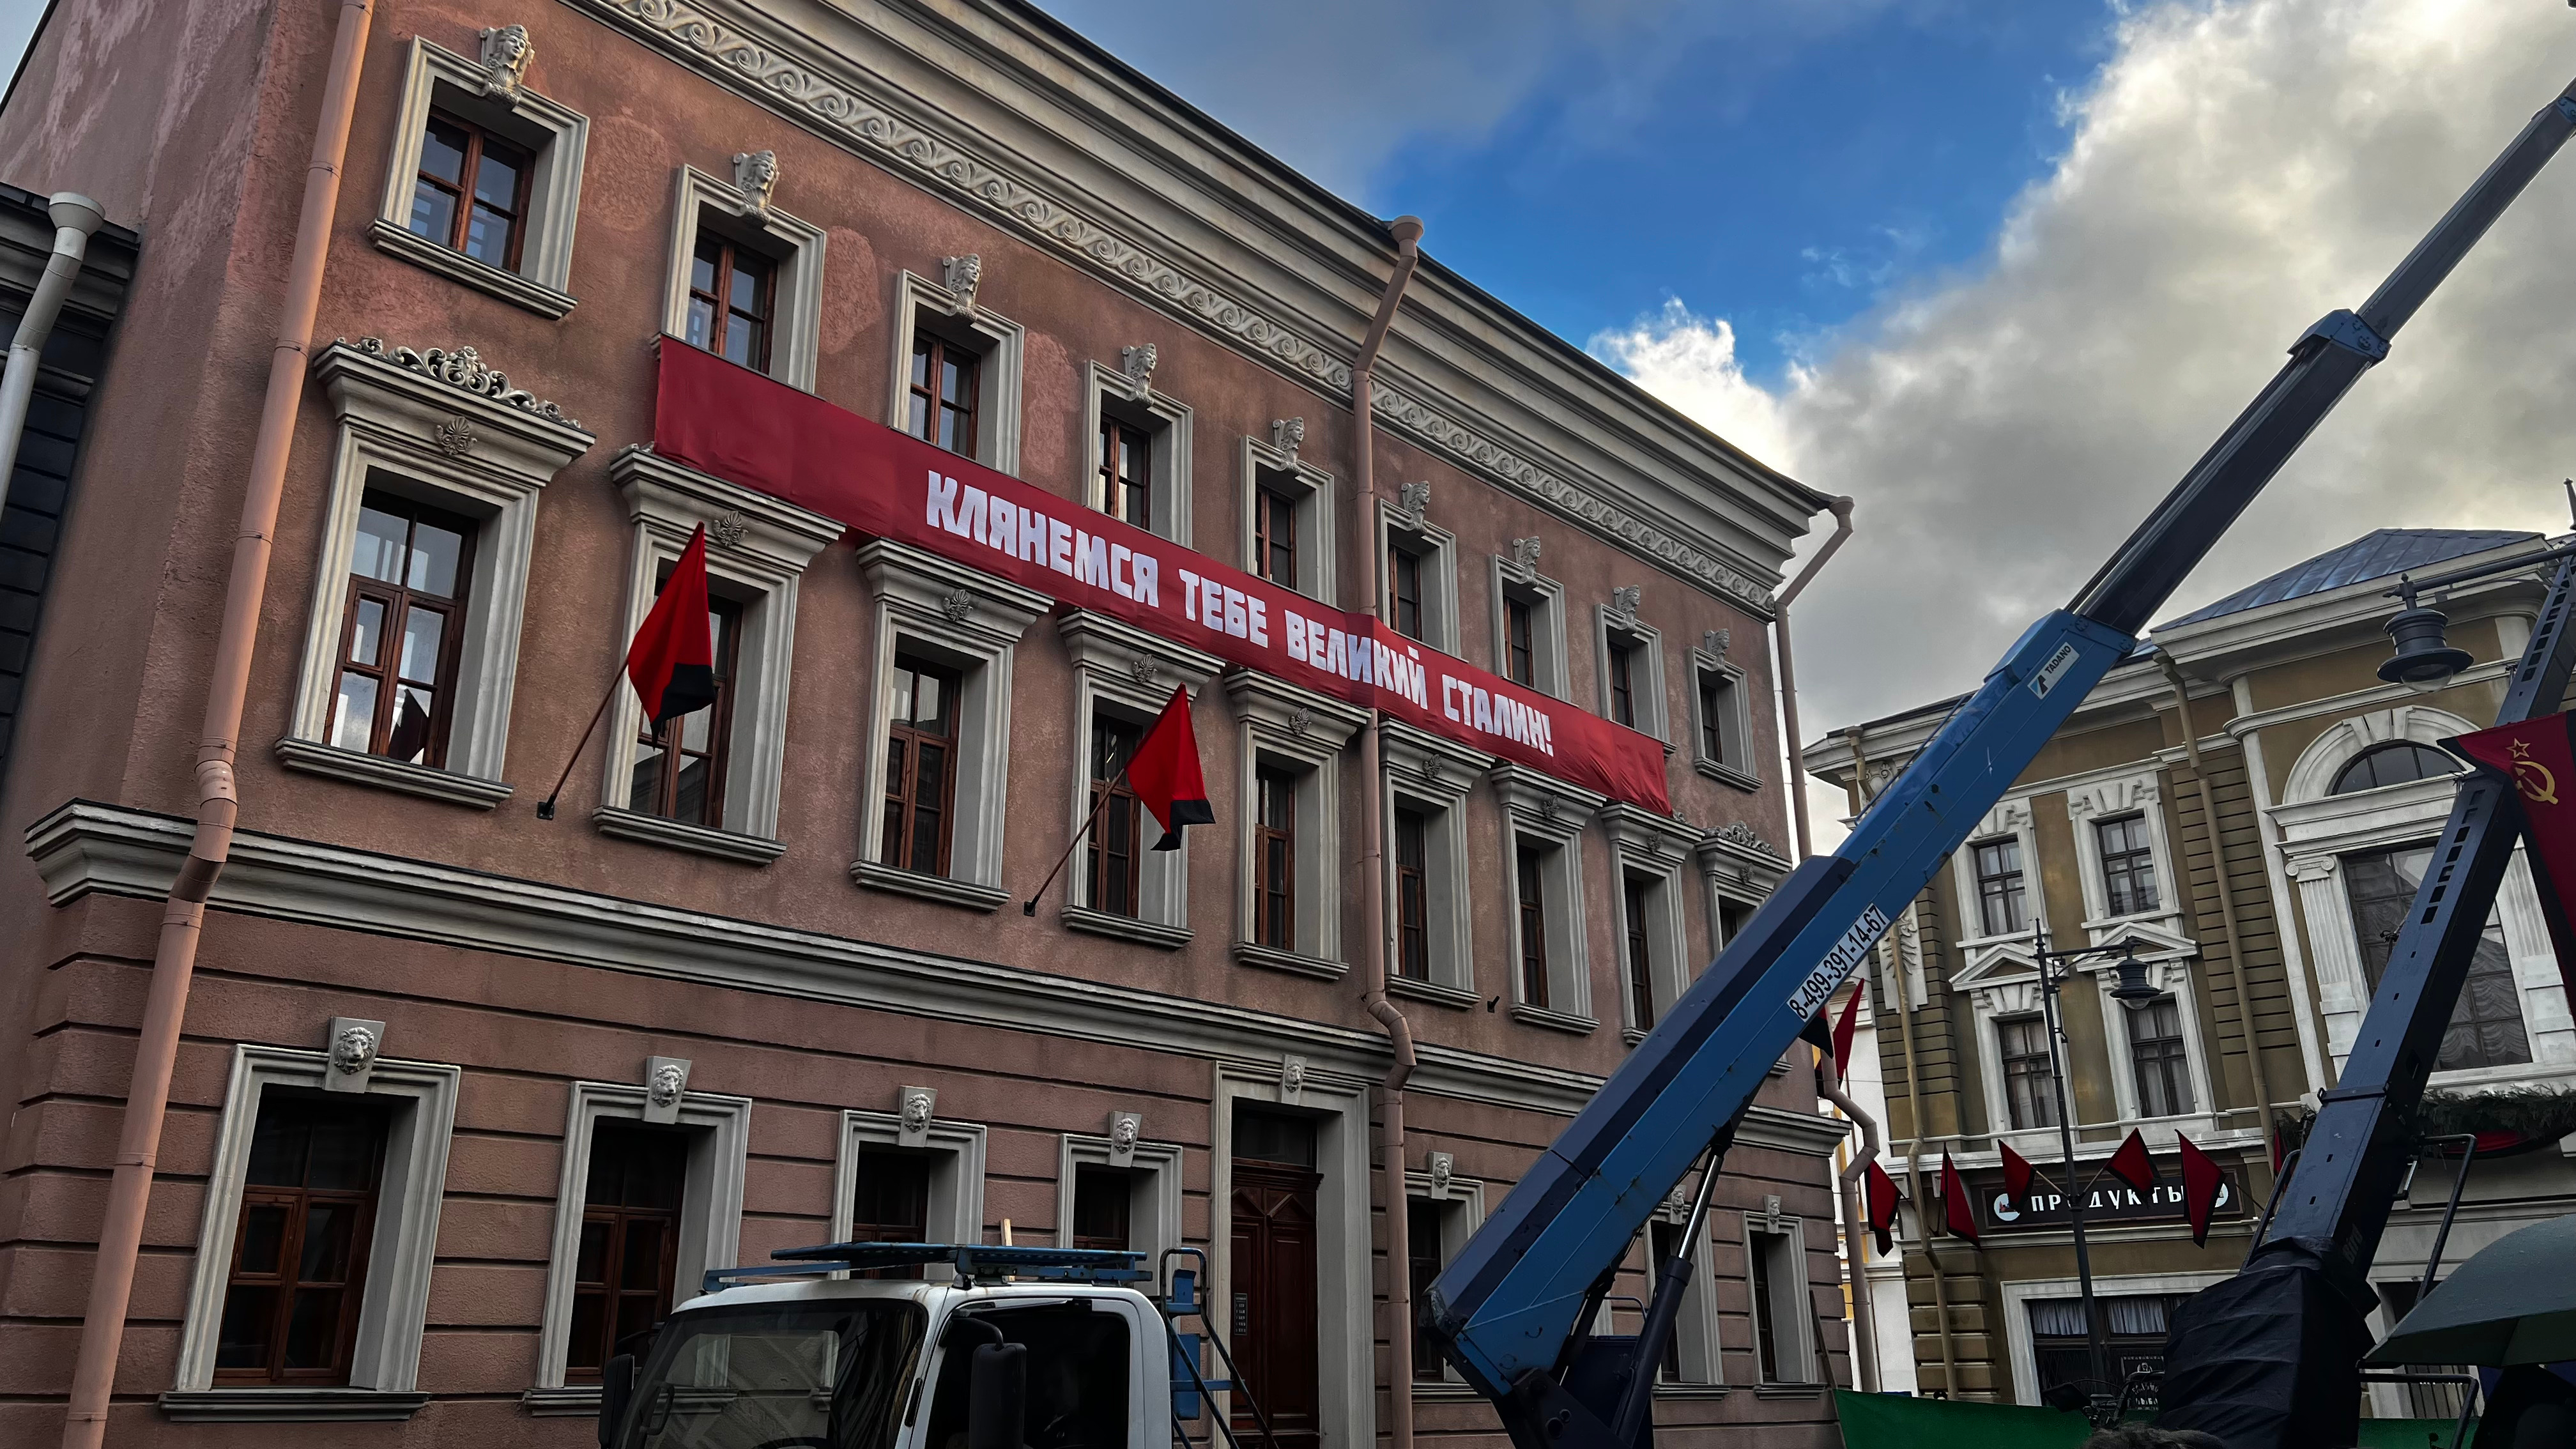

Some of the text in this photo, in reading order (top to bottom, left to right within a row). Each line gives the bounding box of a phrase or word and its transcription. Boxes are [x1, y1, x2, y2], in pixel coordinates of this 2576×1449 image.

[926, 470, 1554, 757] КЛЯНЕМСЯ ТЕБЕ ВЕЛИКИЙ СТАЛИН!
[2045, 645, 2071, 674] TADANO
[1789, 904, 1886, 1020] 8-499-391-14-67
[2031, 1185, 2184, 1211] ПРДУКТЫ
